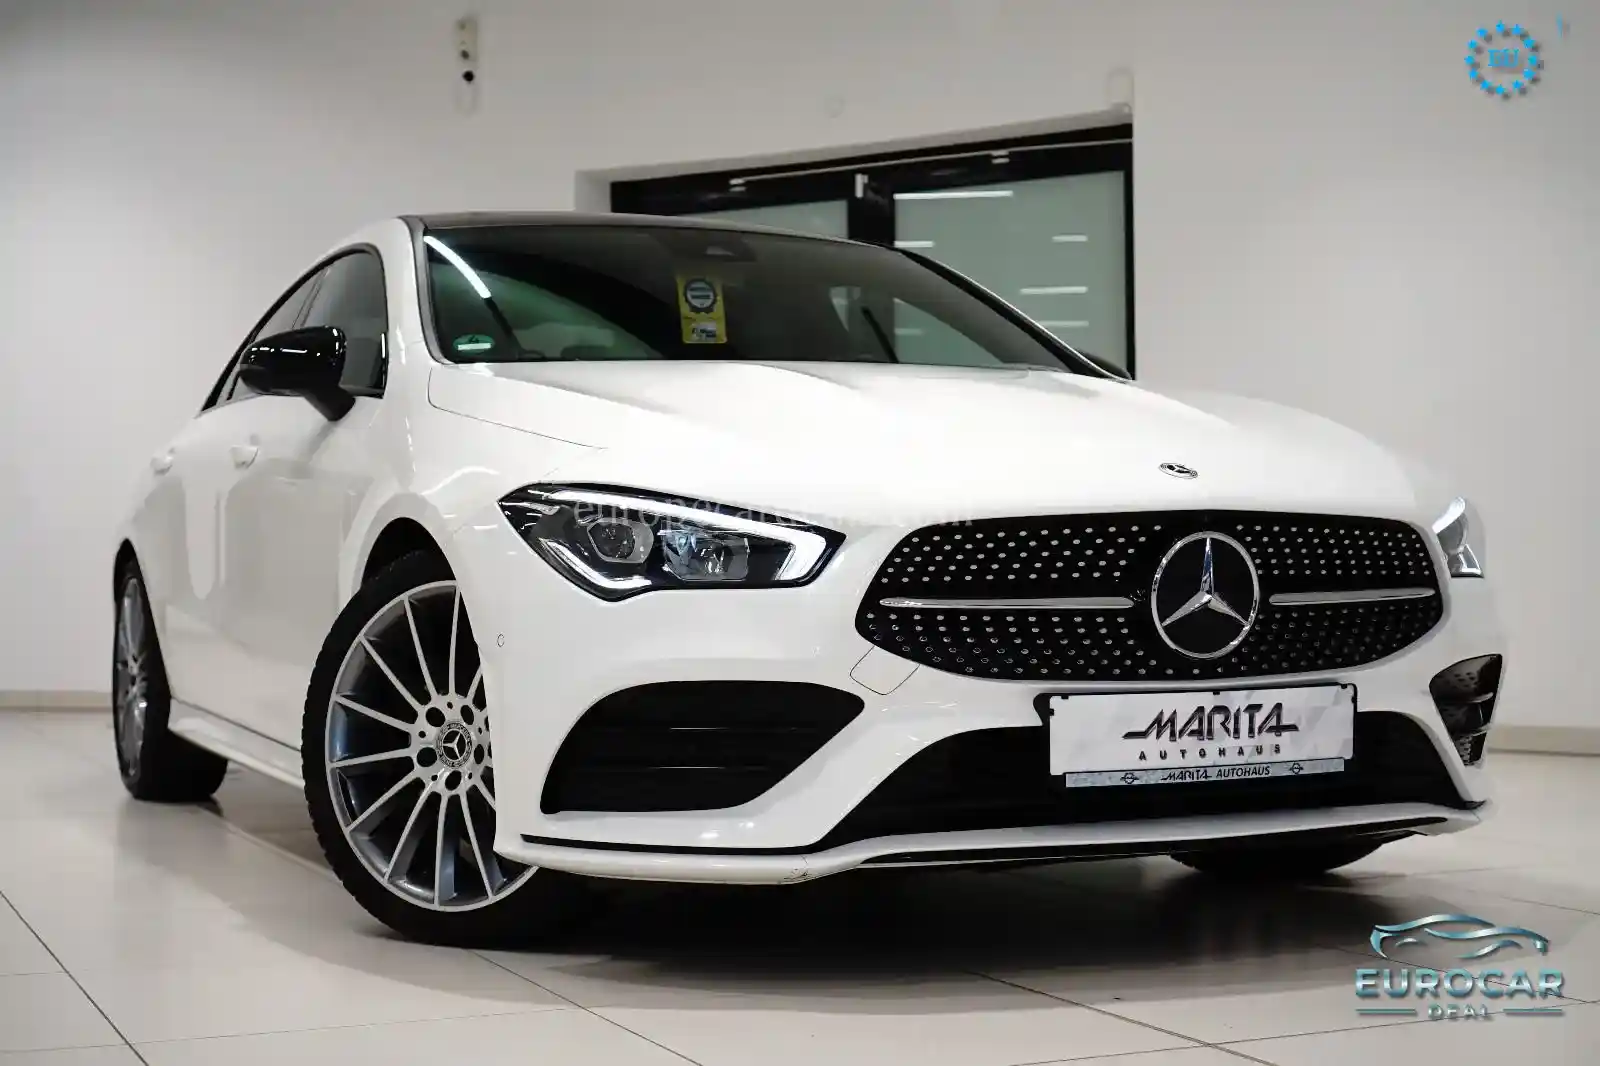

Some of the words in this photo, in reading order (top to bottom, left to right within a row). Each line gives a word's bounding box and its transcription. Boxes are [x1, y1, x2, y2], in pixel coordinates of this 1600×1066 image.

[1122, 702, 1299, 742] MARITA
[1138, 743, 1281, 761] AUTOHAUS
[1161, 769, 1213, 781] MARITA
[1215, 765, 1271, 778] AUTOHAUS
